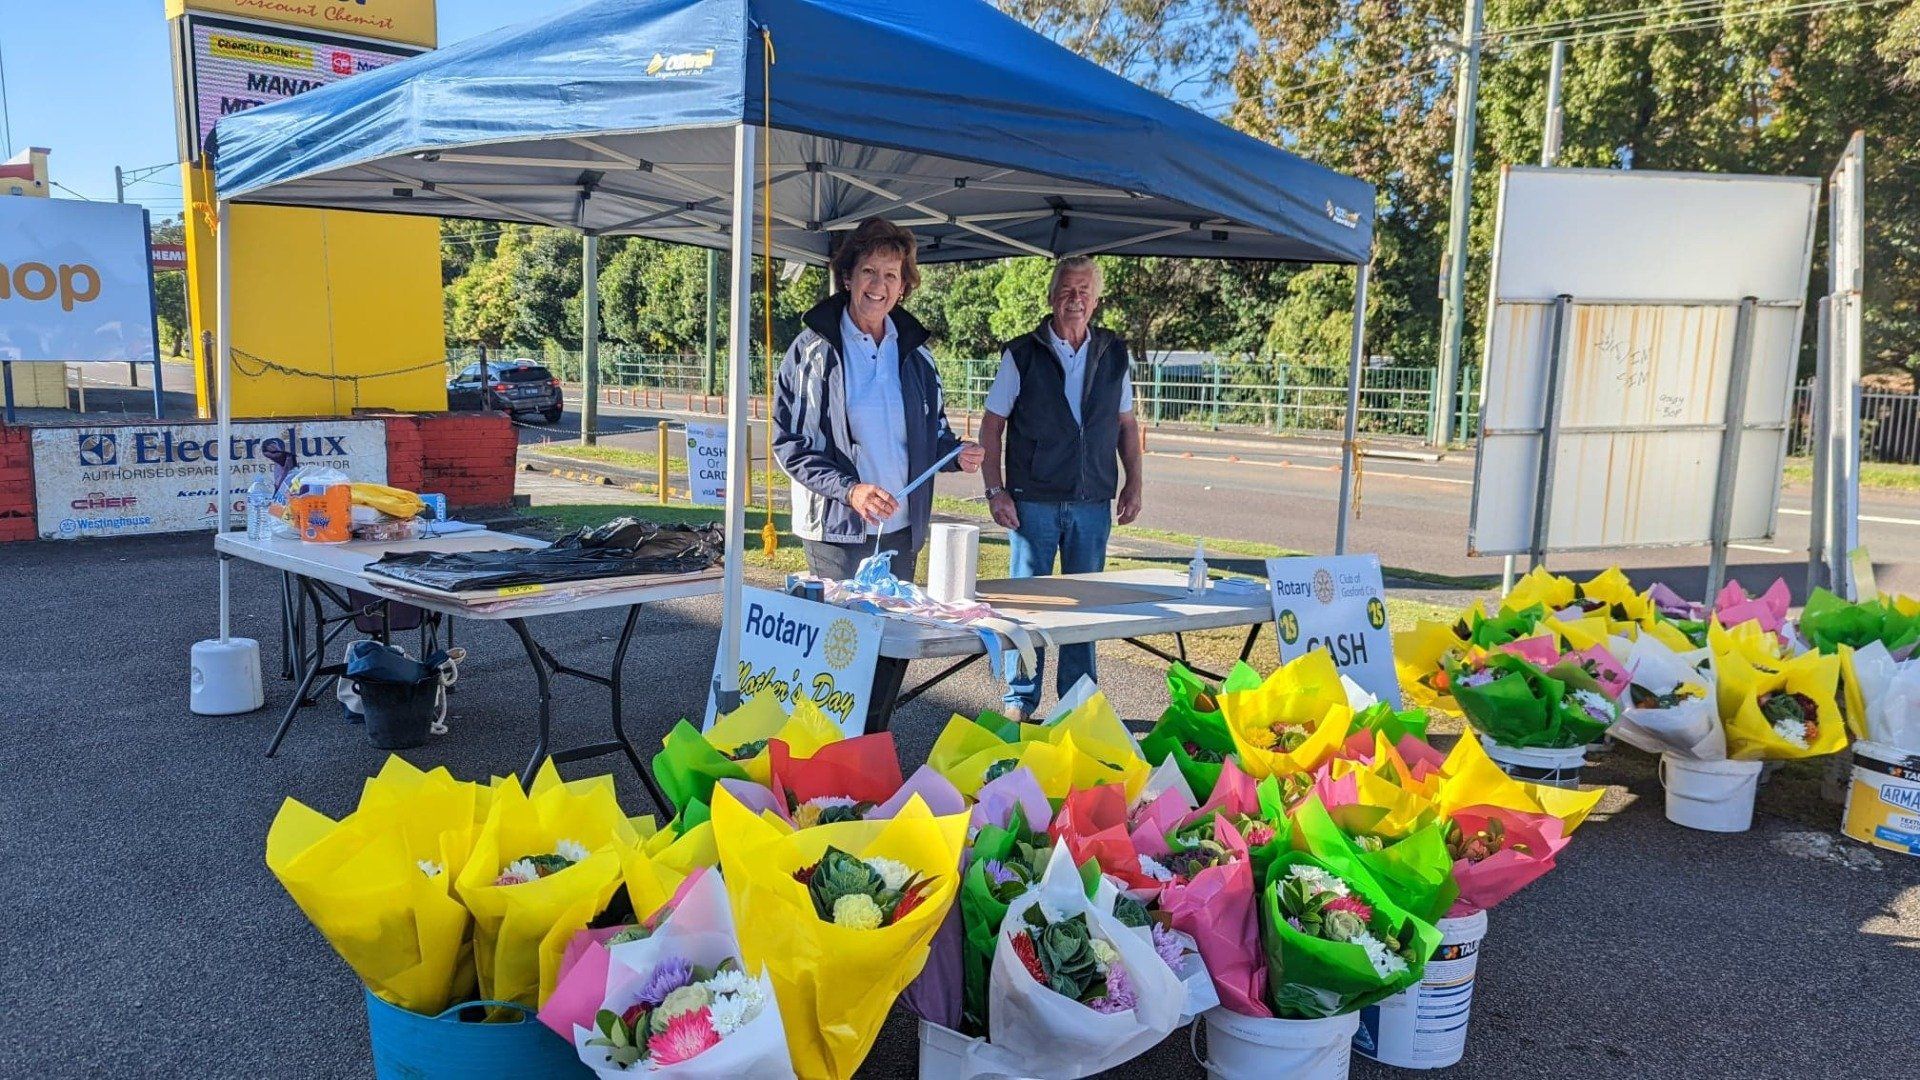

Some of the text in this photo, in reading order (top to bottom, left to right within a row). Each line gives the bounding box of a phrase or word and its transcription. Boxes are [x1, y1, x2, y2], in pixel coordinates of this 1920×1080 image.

[324, 6, 394, 29] Chemist
[217, 38, 259, 54] Chemist
[135, 427, 348, 464] Electrolux
[707, 458, 720, 468] Or
[82, 468, 175, 481] AUTHORISED
[177, 466, 219, 477] SPARE
[71, 496, 137, 510] CHEF
[205, 500, 246, 514] AG
[77, 516, 151, 529] Westinghouse
[1277, 580, 1311, 597] Rotary
[745, 602, 820, 658] Rotary
[810, 672, 855, 724] Day
